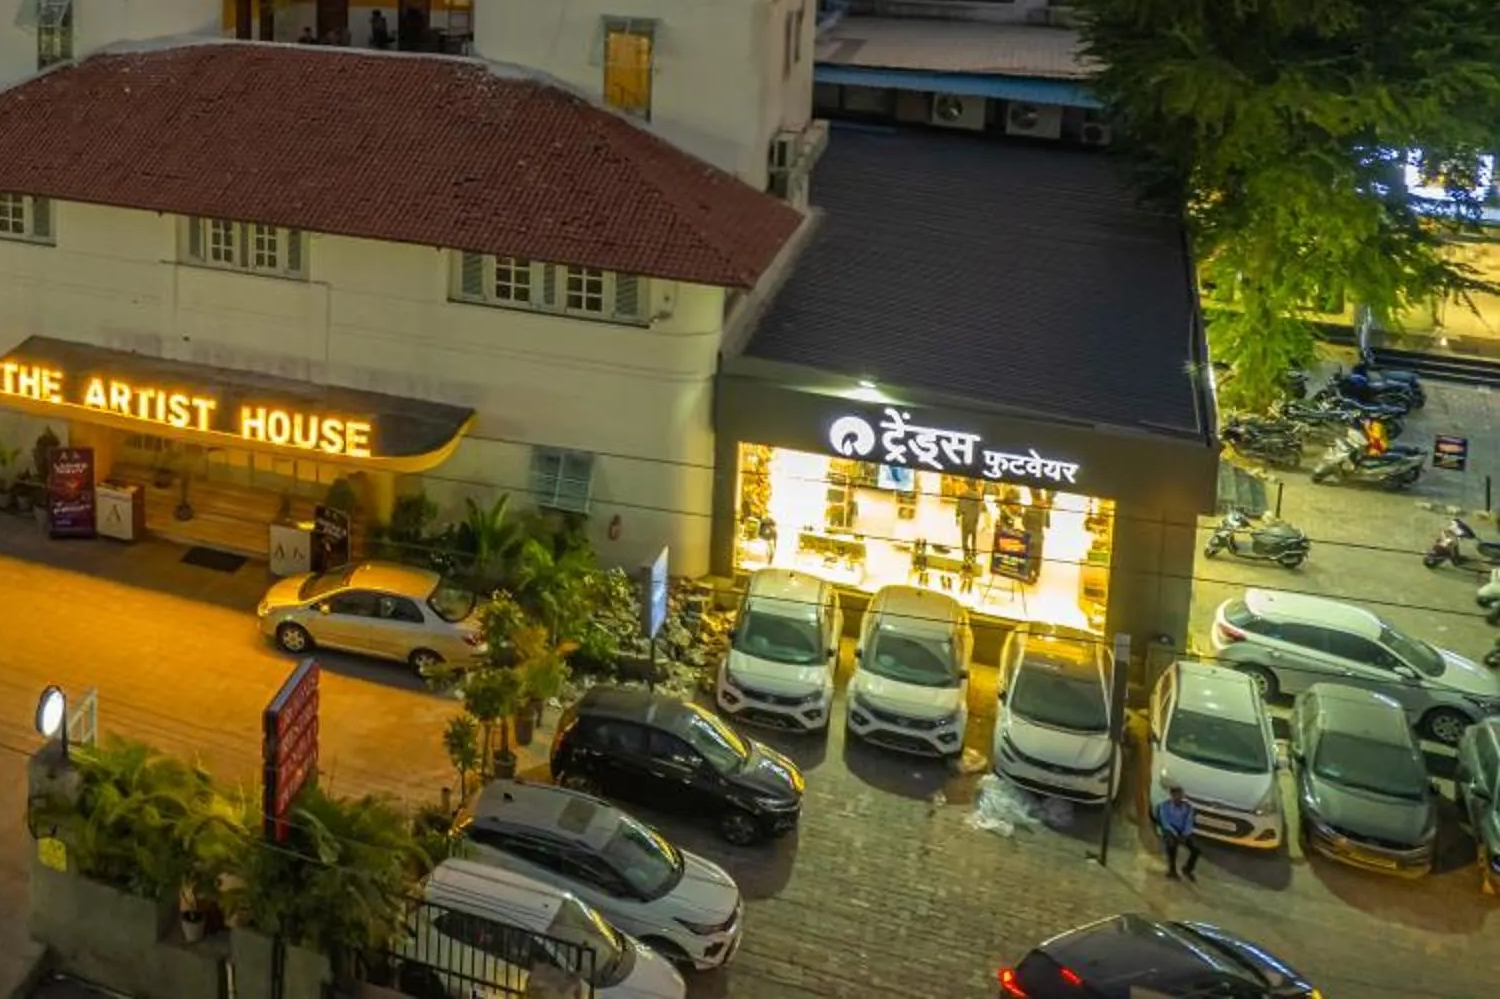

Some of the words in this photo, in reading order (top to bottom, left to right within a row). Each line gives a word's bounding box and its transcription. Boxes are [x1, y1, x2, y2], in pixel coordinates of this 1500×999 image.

[84, 378, 217, 431] ARTIST
[241, 406, 373, 457] HOUSE
[879, 407, 981, 470] ट्रेंड्स
[982, 448, 1079, 484] फुटवेयर
